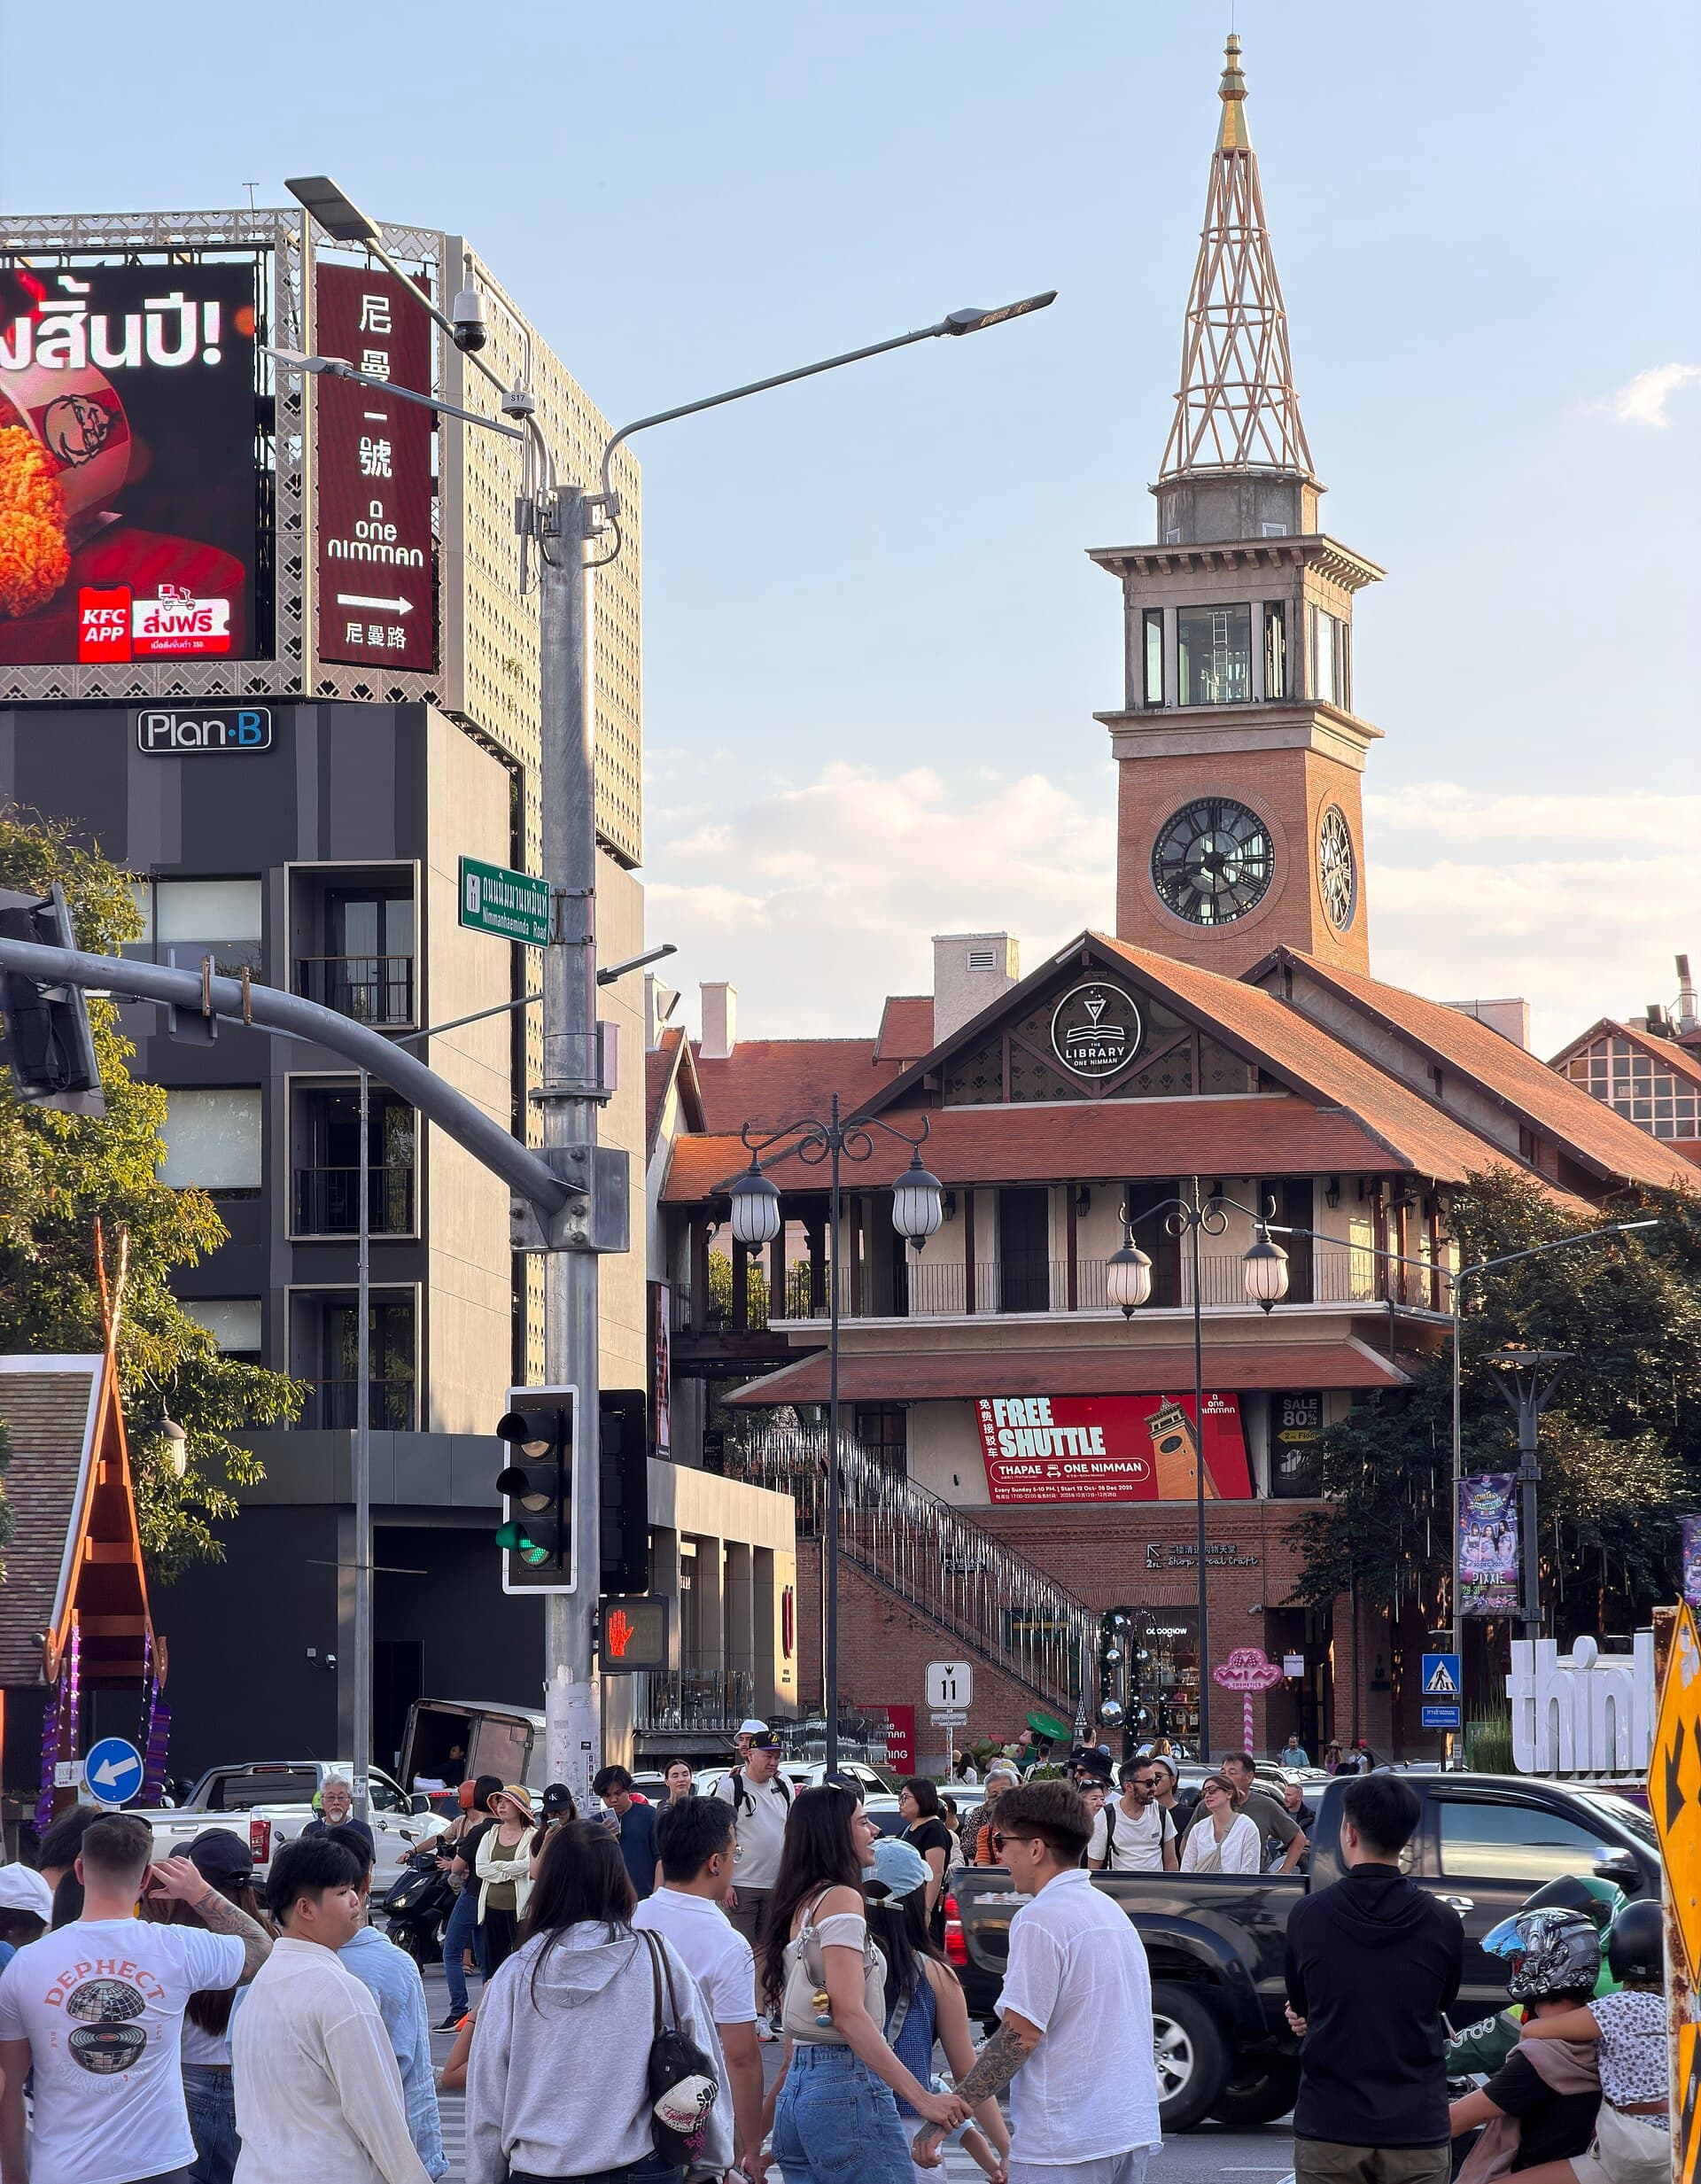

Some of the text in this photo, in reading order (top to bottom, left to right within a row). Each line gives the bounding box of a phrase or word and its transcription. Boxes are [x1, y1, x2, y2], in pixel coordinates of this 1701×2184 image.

[82, 609, 126, 625] KFC
[144, 608, 213, 633] ส่งฟรี
[84, 626, 124, 642] APP
[346, 622, 407, 649] 尼曼路
[532, 921, 548, 940] Road
[1066, 1046, 1126, 1059] LIBRARY
[992, 1397, 1054, 1427] FREE
[1283, 1399, 1318, 1411] SALE
[978, 1398, 998, 1458] 免费接驳车
[998, 1426, 1107, 1457] SHUTTLE
[998, 1462, 1142, 1475] THAPAE ONE NIMMAN
[1169, 1557, 1195, 1569] Shop
[1228, 1556, 1258, 1566] Craft
[941, 1679, 956, 1700] 11
[43, 1958, 167, 2008] DEPHECT
